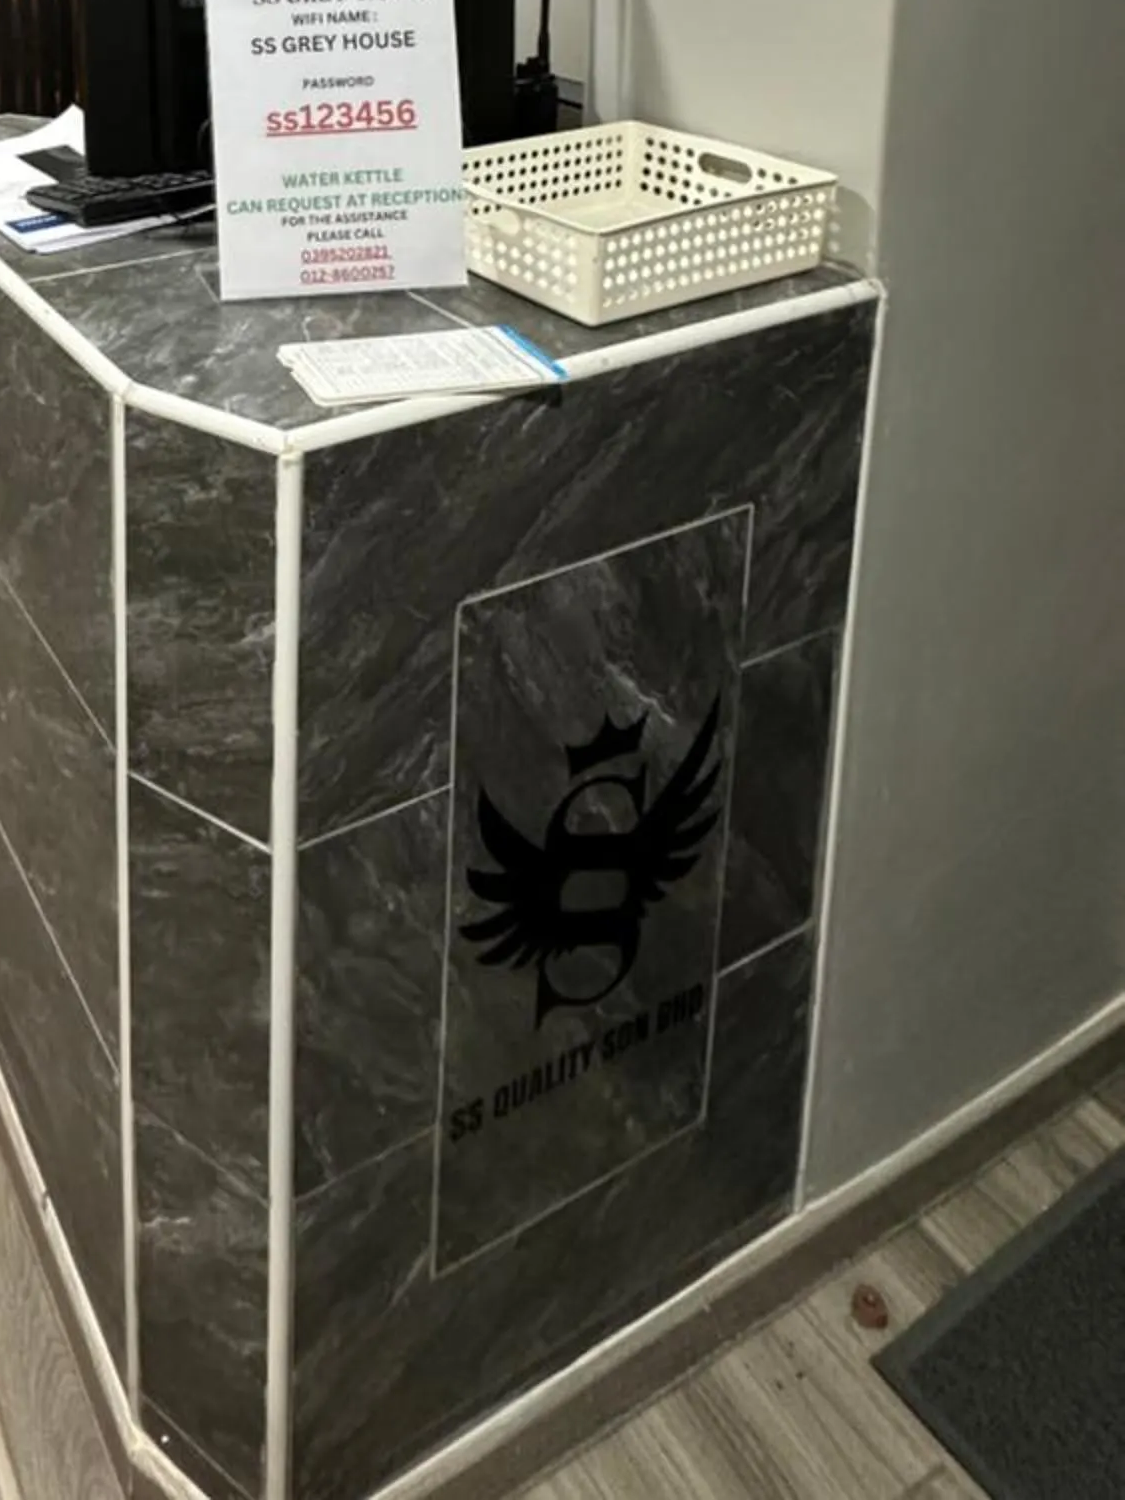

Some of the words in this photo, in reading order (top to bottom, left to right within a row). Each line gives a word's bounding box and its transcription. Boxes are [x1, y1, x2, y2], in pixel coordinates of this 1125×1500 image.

[291, 11, 323, 26] WIFI
[251, 37, 276, 55] SS
[282, 33, 336, 53] GREY
[343, 30, 416, 50] HOUSE
[302, 75, 375, 90] PASSWORD
[282, 171, 340, 189] WATER
[344, 167, 404, 185] KETTLE
[227, 196, 262, 215] CAN
[267, 193, 341, 213] REQUEST
[345, 191, 367, 208] AT
[371, 187, 463, 206] RECEPTION
[281, 216, 306, 227] FOR
[309, 213, 333, 226] THE
[335, 209, 407, 224] ASSISTANCE
[307, 230, 351, 242] PLEASE
[354, 228, 384, 240] CALL
[450, 1096, 484, 1142] SS
[493, 1041, 595, 1118] QUALITY
[656, 982, 703, 1035] BHD
